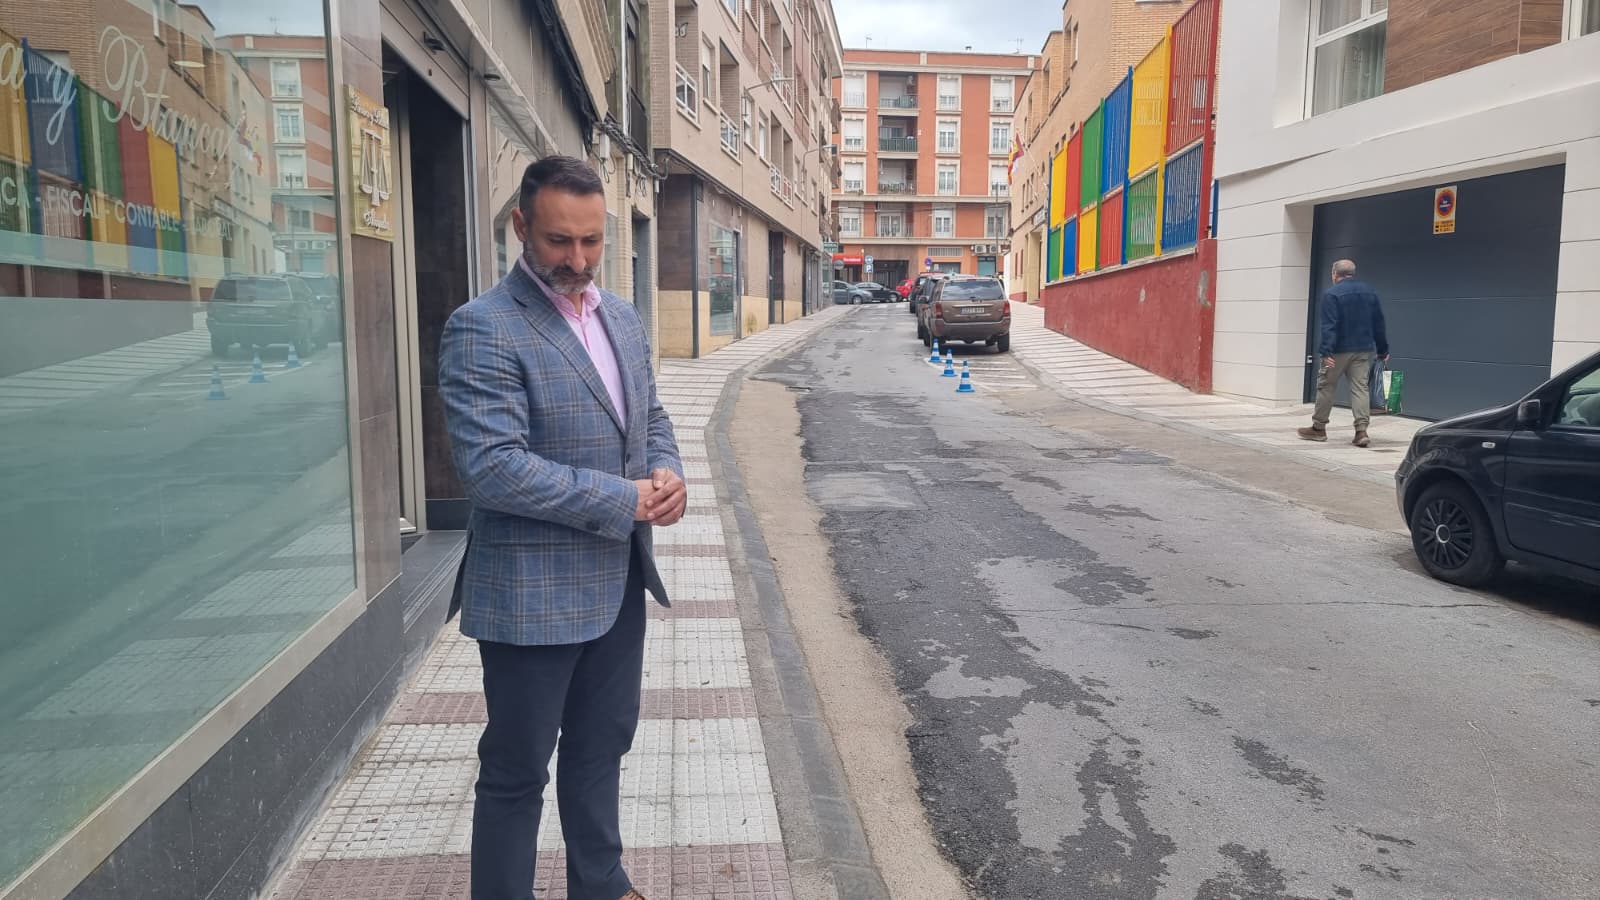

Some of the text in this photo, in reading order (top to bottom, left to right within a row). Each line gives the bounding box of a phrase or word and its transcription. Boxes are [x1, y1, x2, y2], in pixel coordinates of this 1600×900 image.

[46, 62, 78, 146] y
[47, 184, 102, 220] FISCAL
[114, 200, 180, 232] CONTABLE
